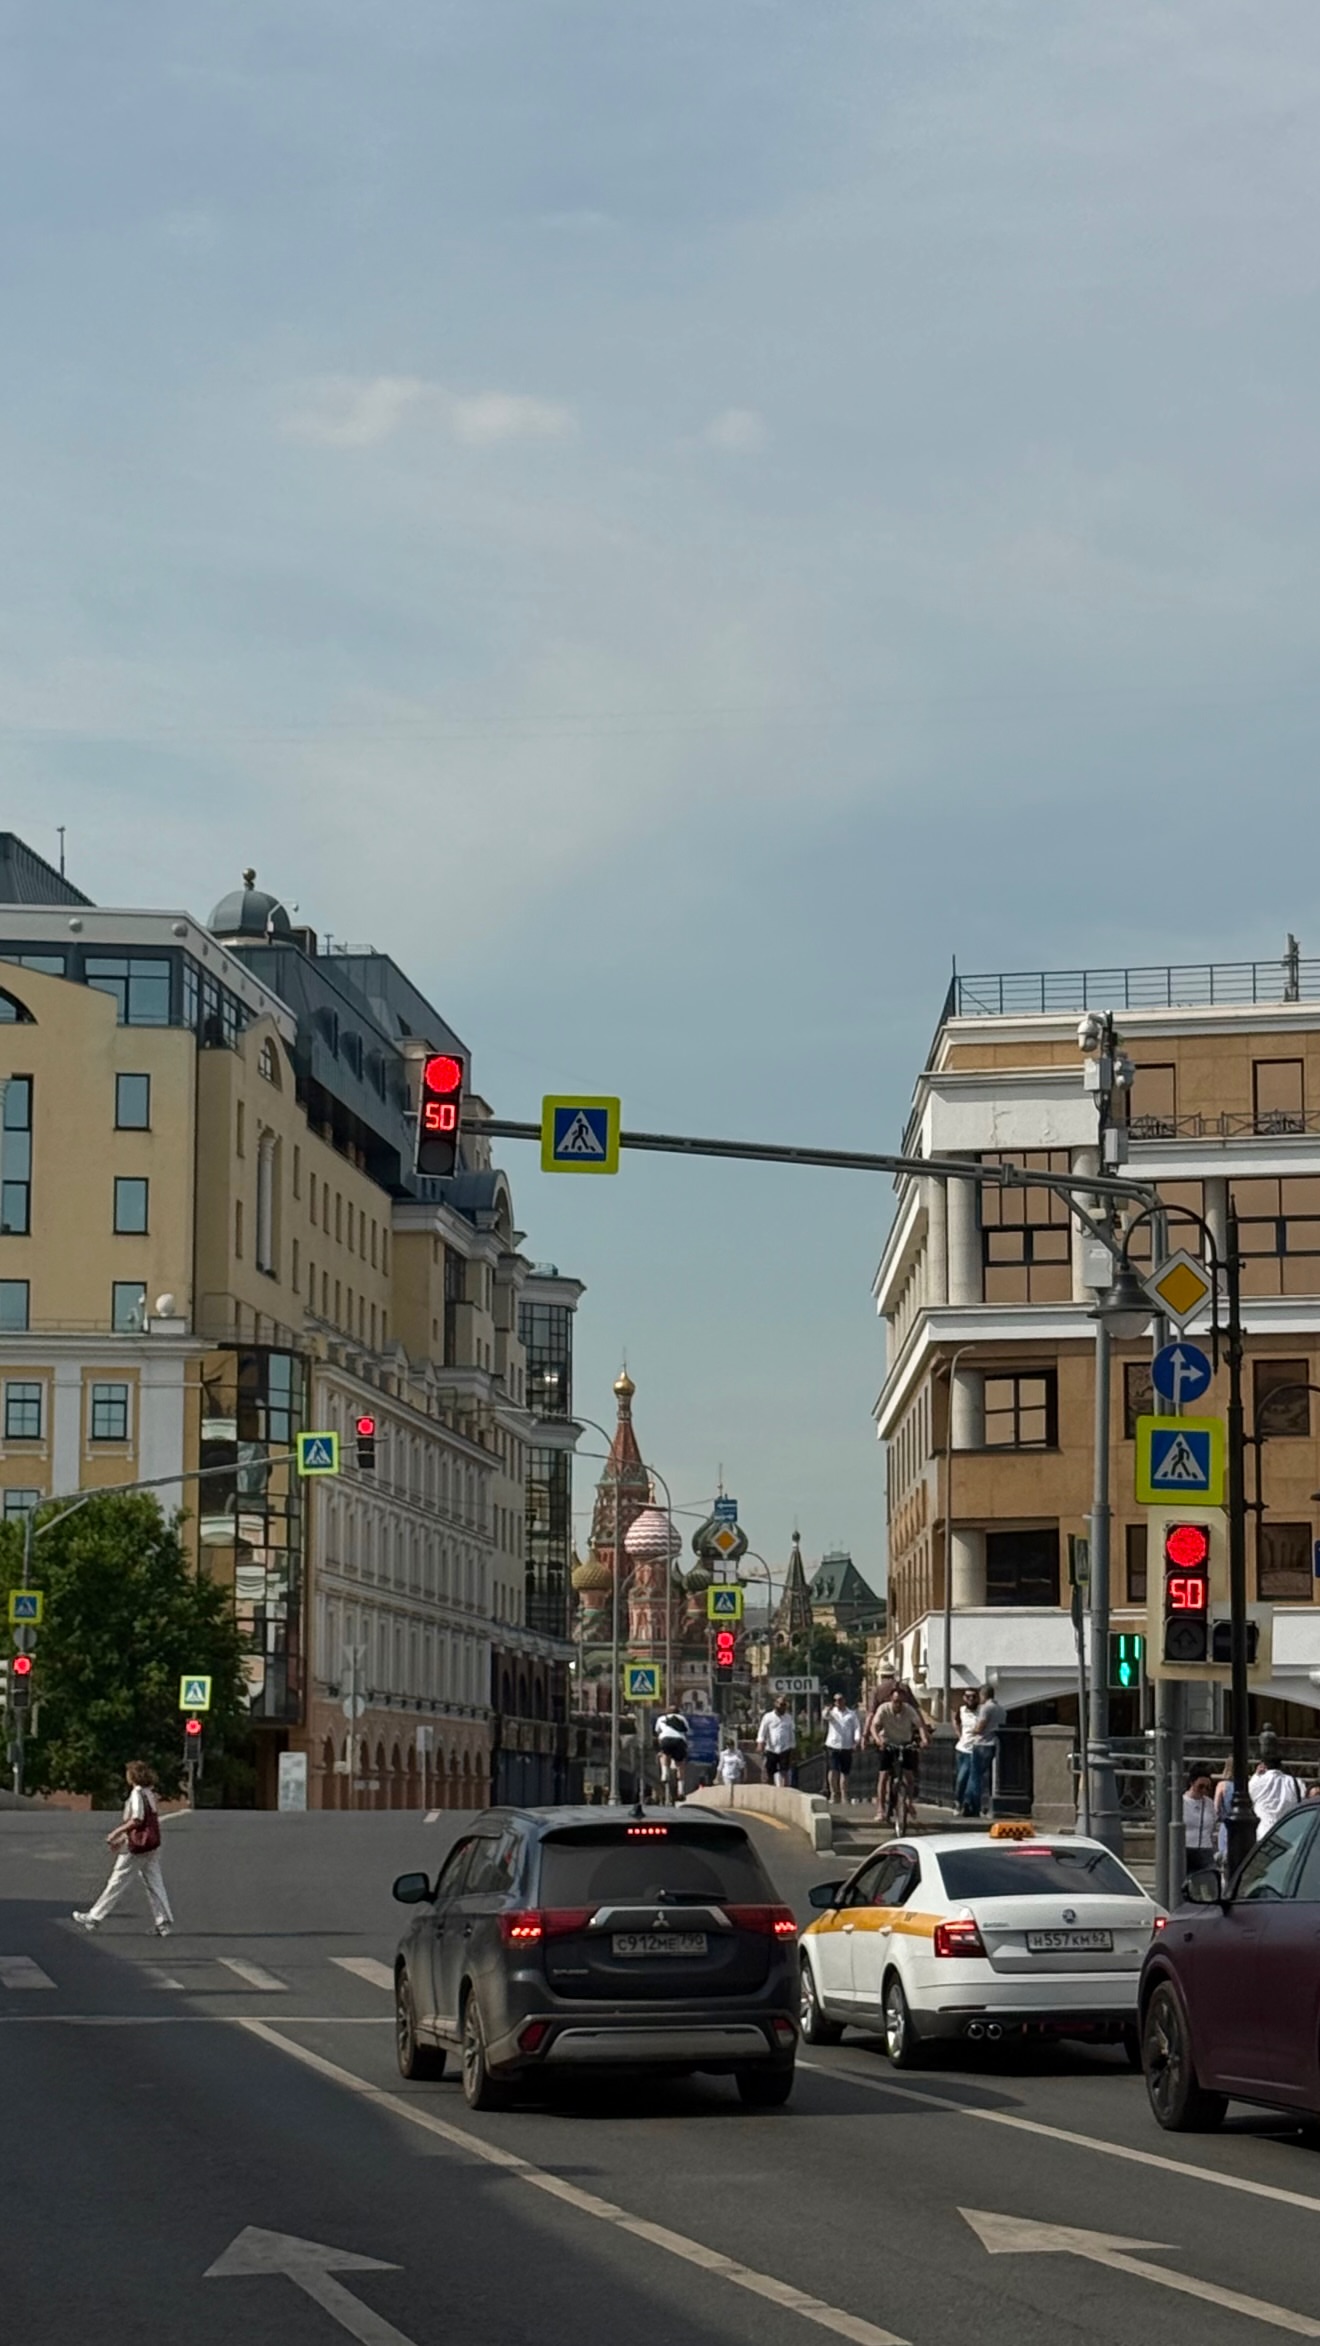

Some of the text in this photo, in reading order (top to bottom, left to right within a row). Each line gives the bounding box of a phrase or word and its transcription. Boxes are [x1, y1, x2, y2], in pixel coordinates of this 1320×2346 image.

[425, 1103, 455, 1130] 50
[1171, 1579, 1202, 1608] 50
[717, 1651, 734, 1666] 50
